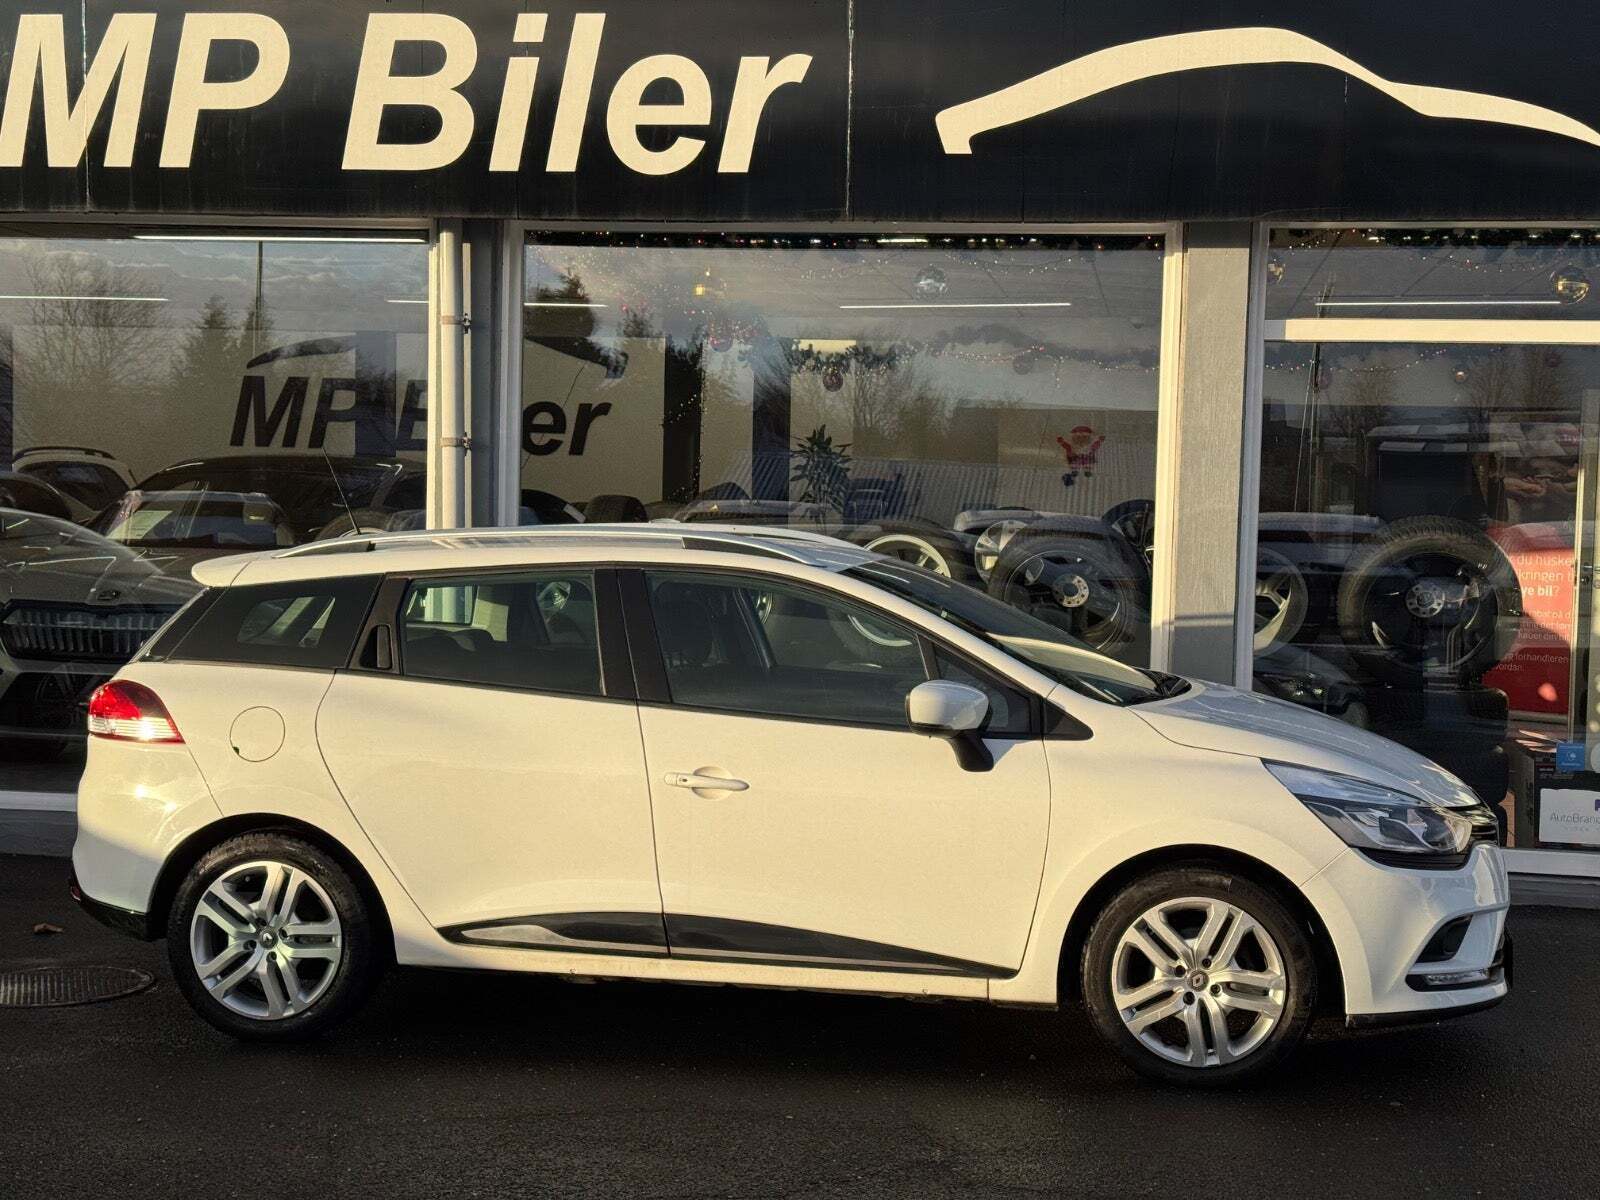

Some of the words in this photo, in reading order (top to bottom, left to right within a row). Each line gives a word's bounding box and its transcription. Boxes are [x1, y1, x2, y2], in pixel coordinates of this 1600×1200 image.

[0, 13, 291, 168] MP
[341, 12, 813, 176] Biler
[229, 375, 369, 449] MP
[1516, 553, 1533, 566] du
[1521, 585, 1535, 599] ye
